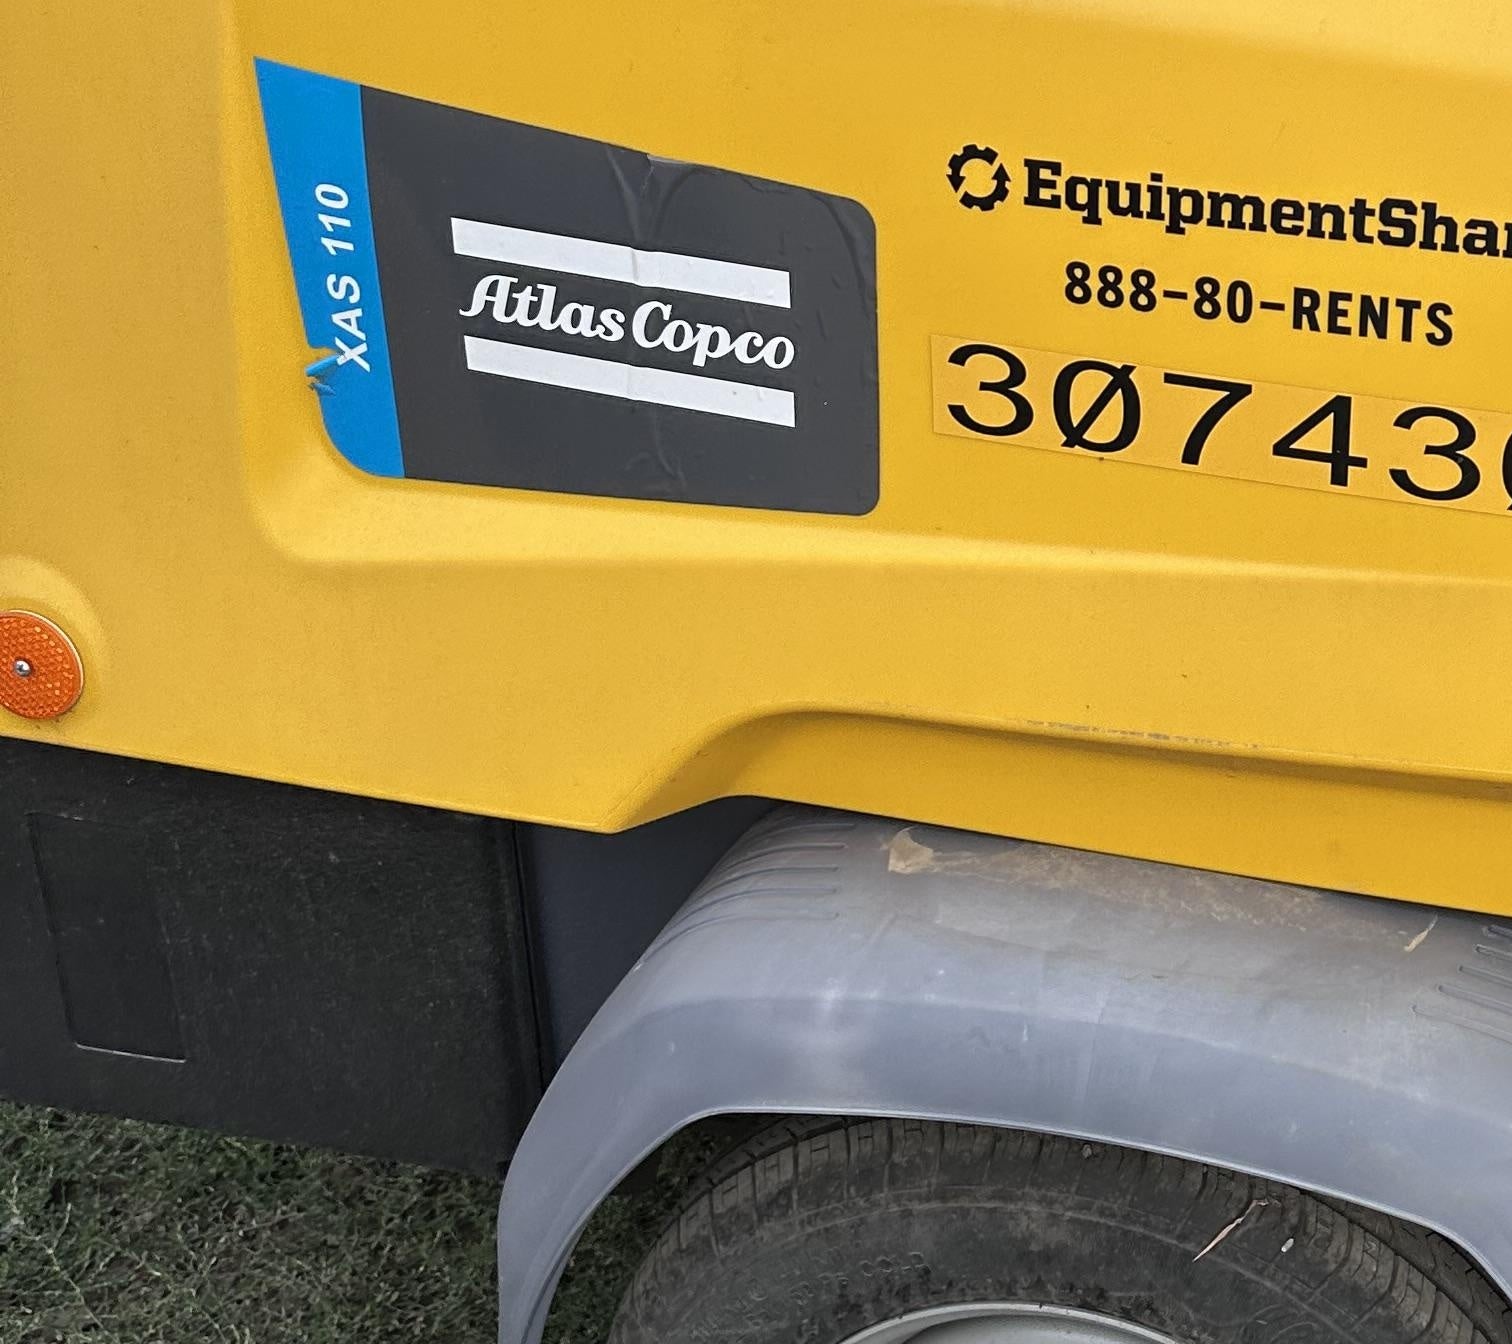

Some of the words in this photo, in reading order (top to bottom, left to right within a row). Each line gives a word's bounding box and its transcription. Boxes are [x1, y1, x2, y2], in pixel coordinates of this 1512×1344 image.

[314, 182, 355, 257] 110
[329, 271, 372, 373] XAS
[458, 272, 625, 342] Atlas
[631, 299, 796, 370] Copco
[1063, 260, 1455, 347] 888-80-RENTS
